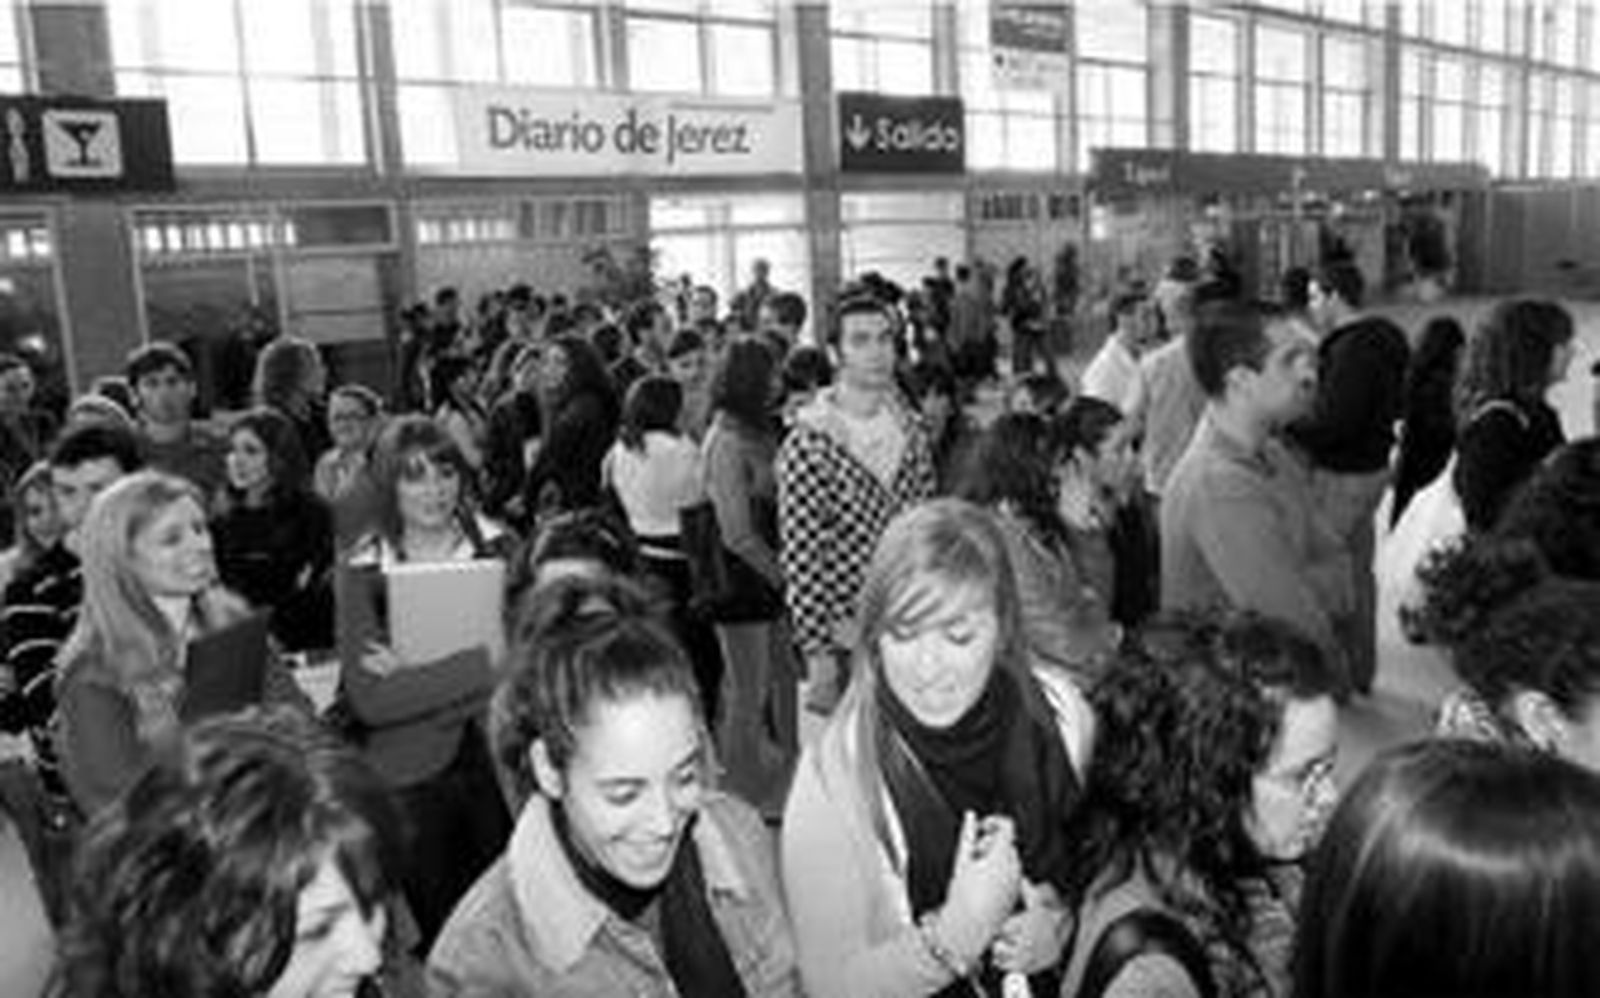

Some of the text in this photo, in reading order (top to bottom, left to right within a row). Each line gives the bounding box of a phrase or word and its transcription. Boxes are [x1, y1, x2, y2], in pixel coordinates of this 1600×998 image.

[486, 106, 751, 166] Diario de Jerez
